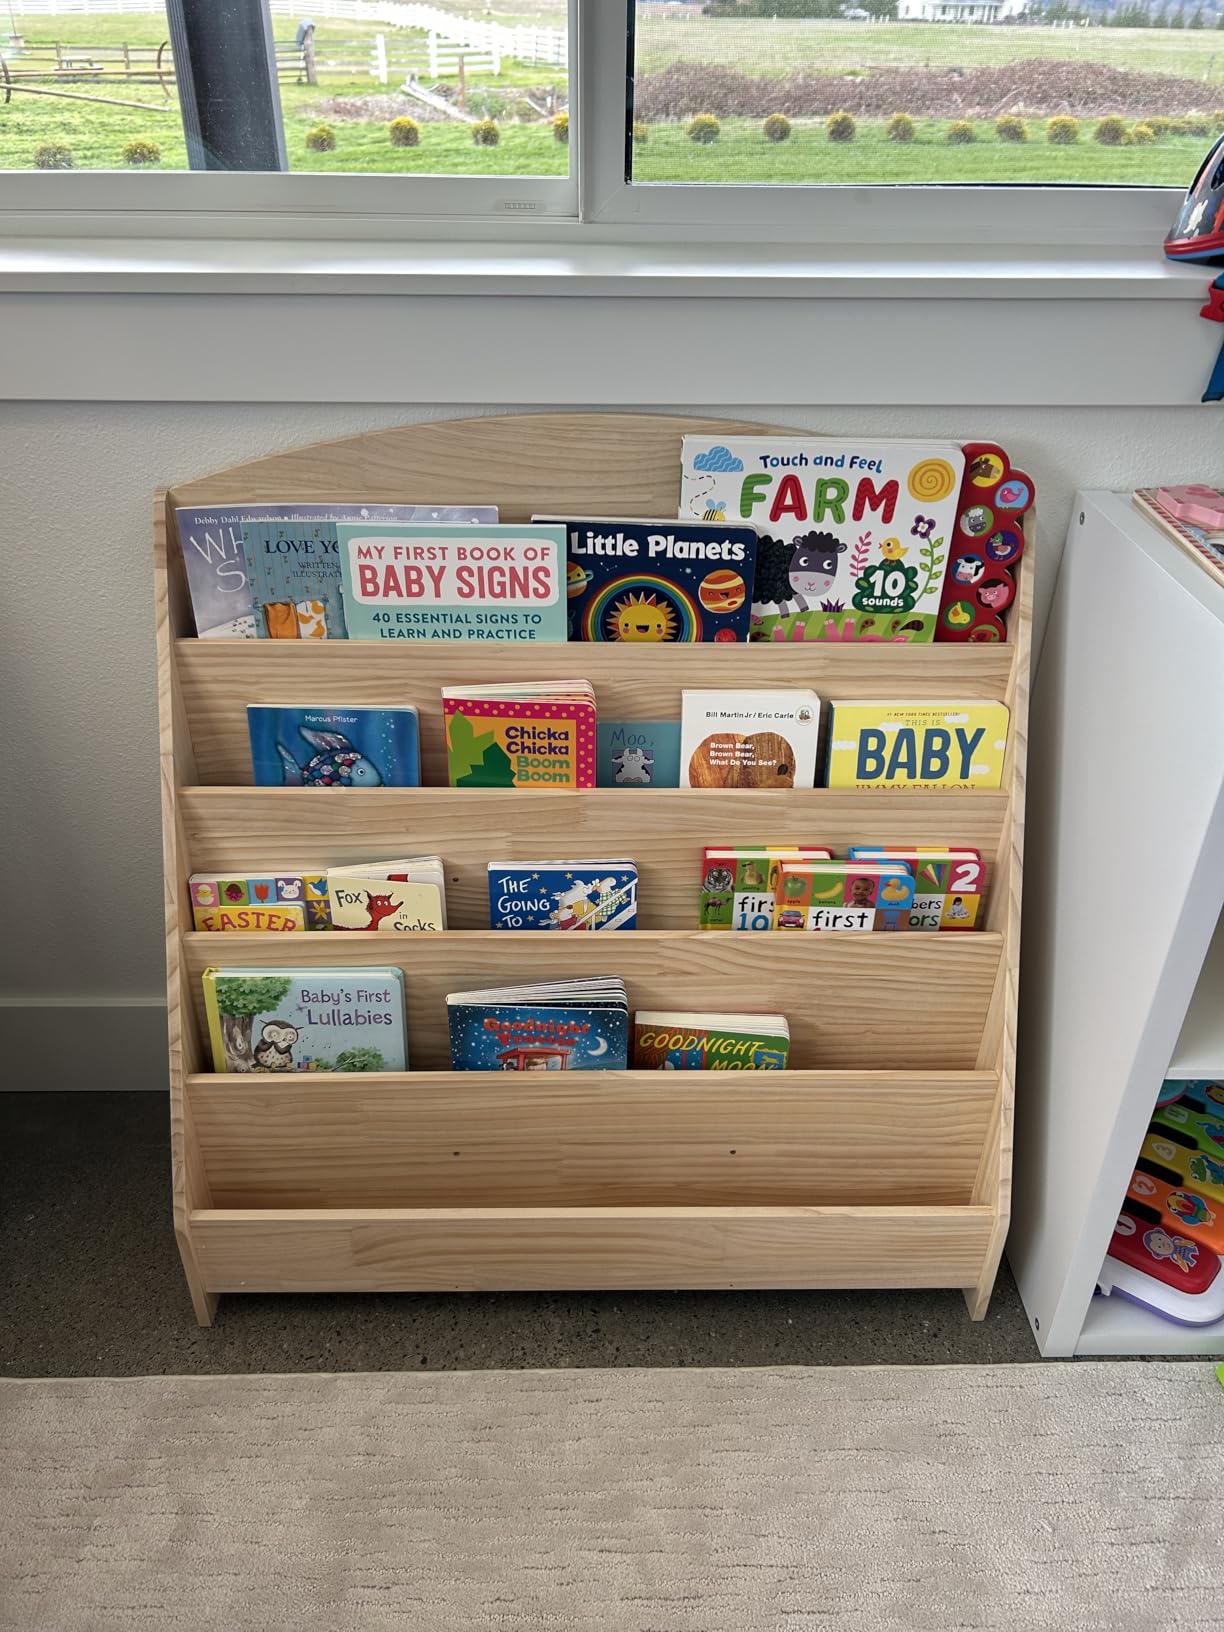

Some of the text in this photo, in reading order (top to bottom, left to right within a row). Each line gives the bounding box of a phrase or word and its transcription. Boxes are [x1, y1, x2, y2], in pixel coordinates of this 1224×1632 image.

[760, 453, 882, 474] Touch and Feel
[740, 474, 900, 524] FARM
[194, 516, 218, 525] Debby
[221, 516, 239, 524] Dahl
[264, 540, 315, 554] LOVE
[357, 545, 550, 561] MY FIRST BOOK OF
[570, 530, 746, 561] Little Planets
[358, 564, 551, 599] BABY SIGNS
[869, 570, 902, 597] 10
[862, 596, 904, 608] sounds
[372, 612, 542, 624] 40 ESSENTIAL SIGNS TO
[380, 628, 536, 640] LEARN AND PRACTICE
[505, 726, 569, 740] Chicka
[506, 741, 569, 755] Chicka
[735, 750, 755, 758] Bear,
[856, 728, 986, 780] BABY
[516, 756, 570, 768] Boom
[518, 769, 570, 782] Boom
[498, 876, 531, 894] THE
[950, 863, 980, 892] 2
[335, 889, 364, 907] Fox
[498, 896, 550, 913] GOING
[202, 912, 296, 931] EASTER
[399, 912, 408, 920] in
[502, 914, 522, 928] TO
[812, 910, 868, 928] first
[908, 914, 940, 926] ors
[301, 988, 392, 1005] Baby's First
[307, 1009, 392, 1026] Lullabies
[483, 1018, 590, 1036] Goodnight
[639, 1032, 764, 1056] GOODNIGHT
